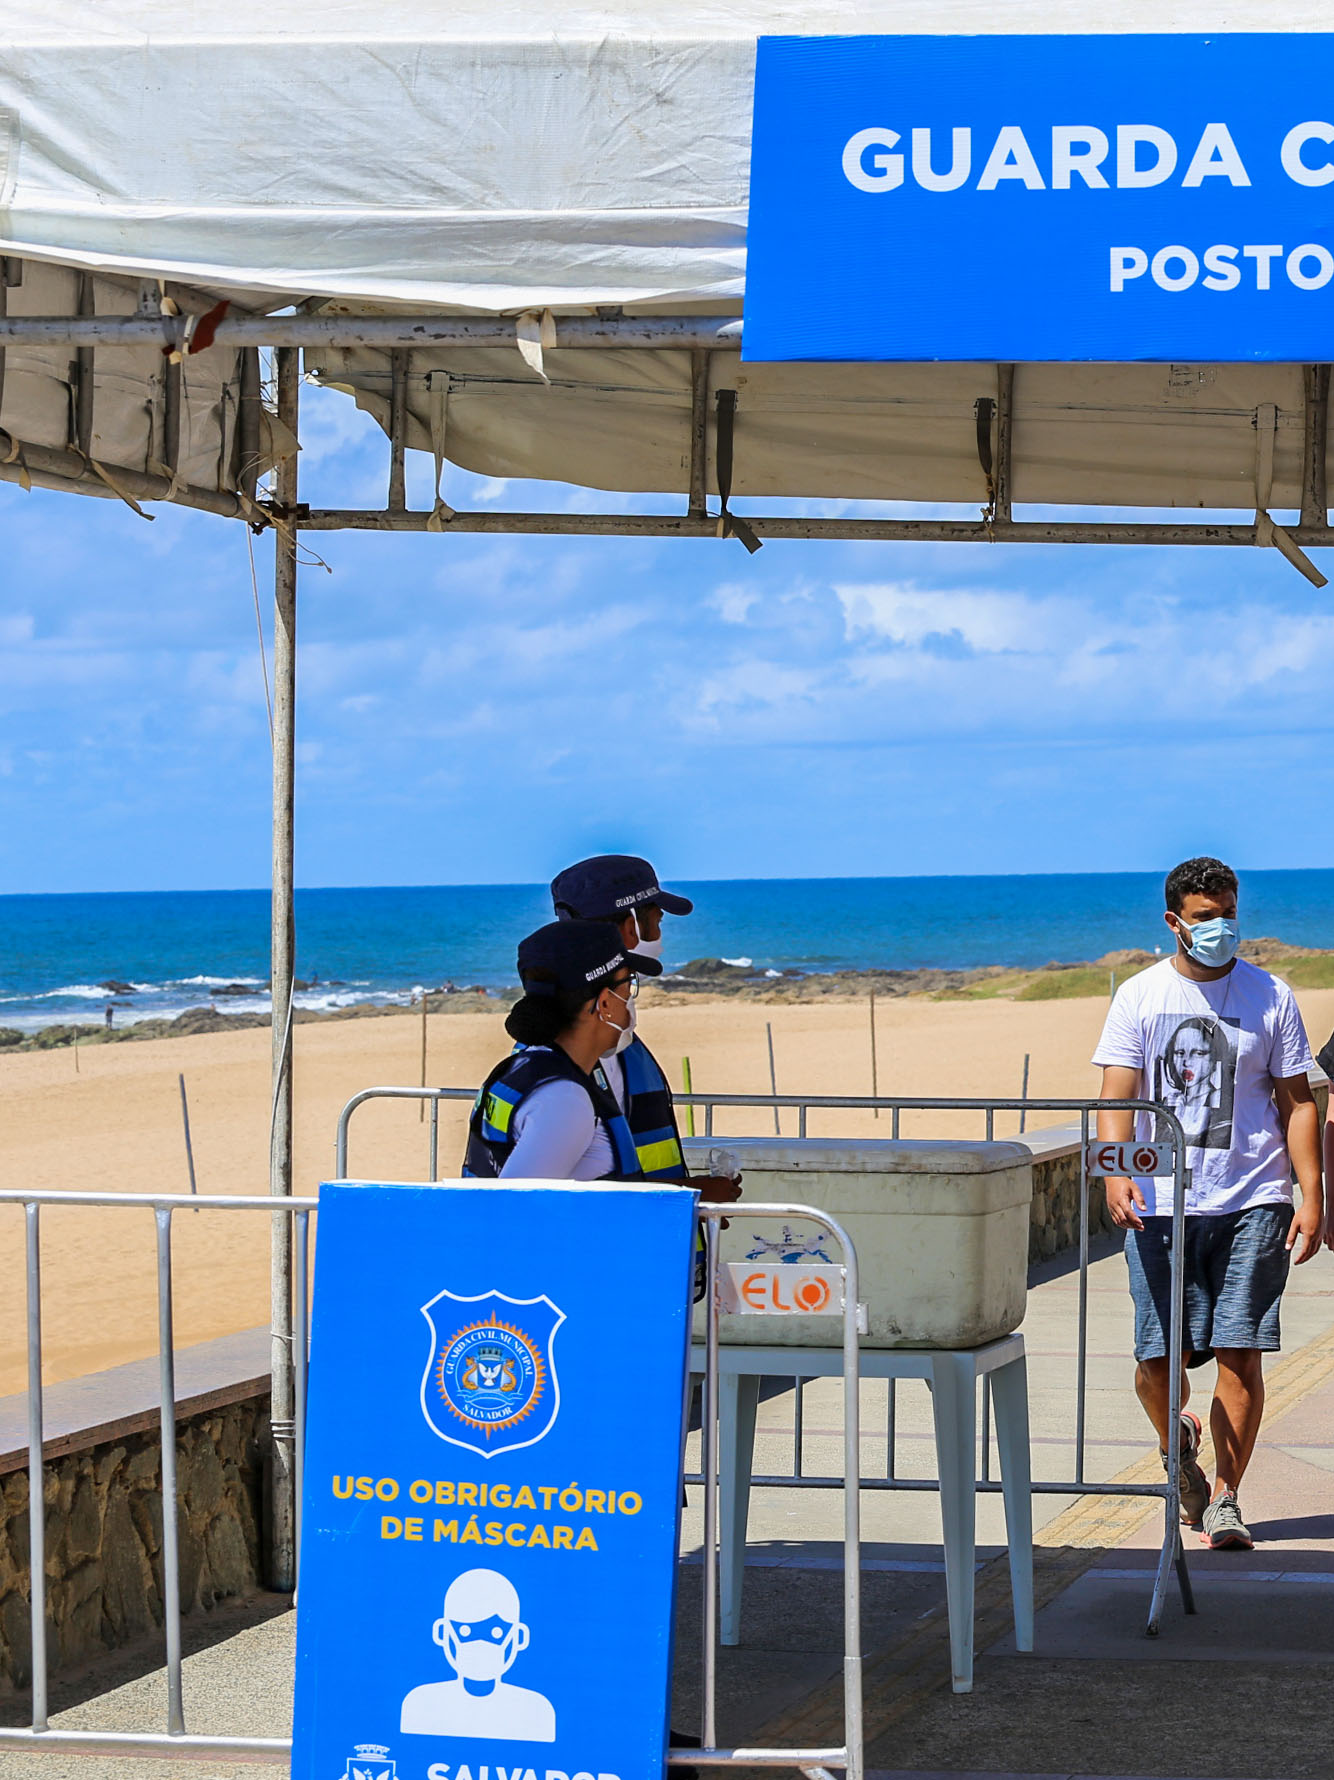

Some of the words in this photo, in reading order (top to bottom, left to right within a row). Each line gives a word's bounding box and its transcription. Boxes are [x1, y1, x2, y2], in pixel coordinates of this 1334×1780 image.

[842, 123, 1252, 193] GUARDA
[1110, 243, 1334, 292] POSTO
[585, 965, 607, 982] GUARDA
[1098, 1145, 1158, 1173] ELO
[742, 1273, 830, 1312] ELO
[446, 1339, 472, 1375] GUARDA
[470, 1330, 497, 1342] CIVIL
[499, 1331, 533, 1378] MUNICIPAL
[463, 1404, 513, 1420] SALVADOR
[331, 1475, 400, 1502] USO
[409, 1480, 643, 1516] OBRIGATÓRIO
[381, 1516, 424, 1542] DE
[434, 1514, 600, 1551] MÁSCARA
